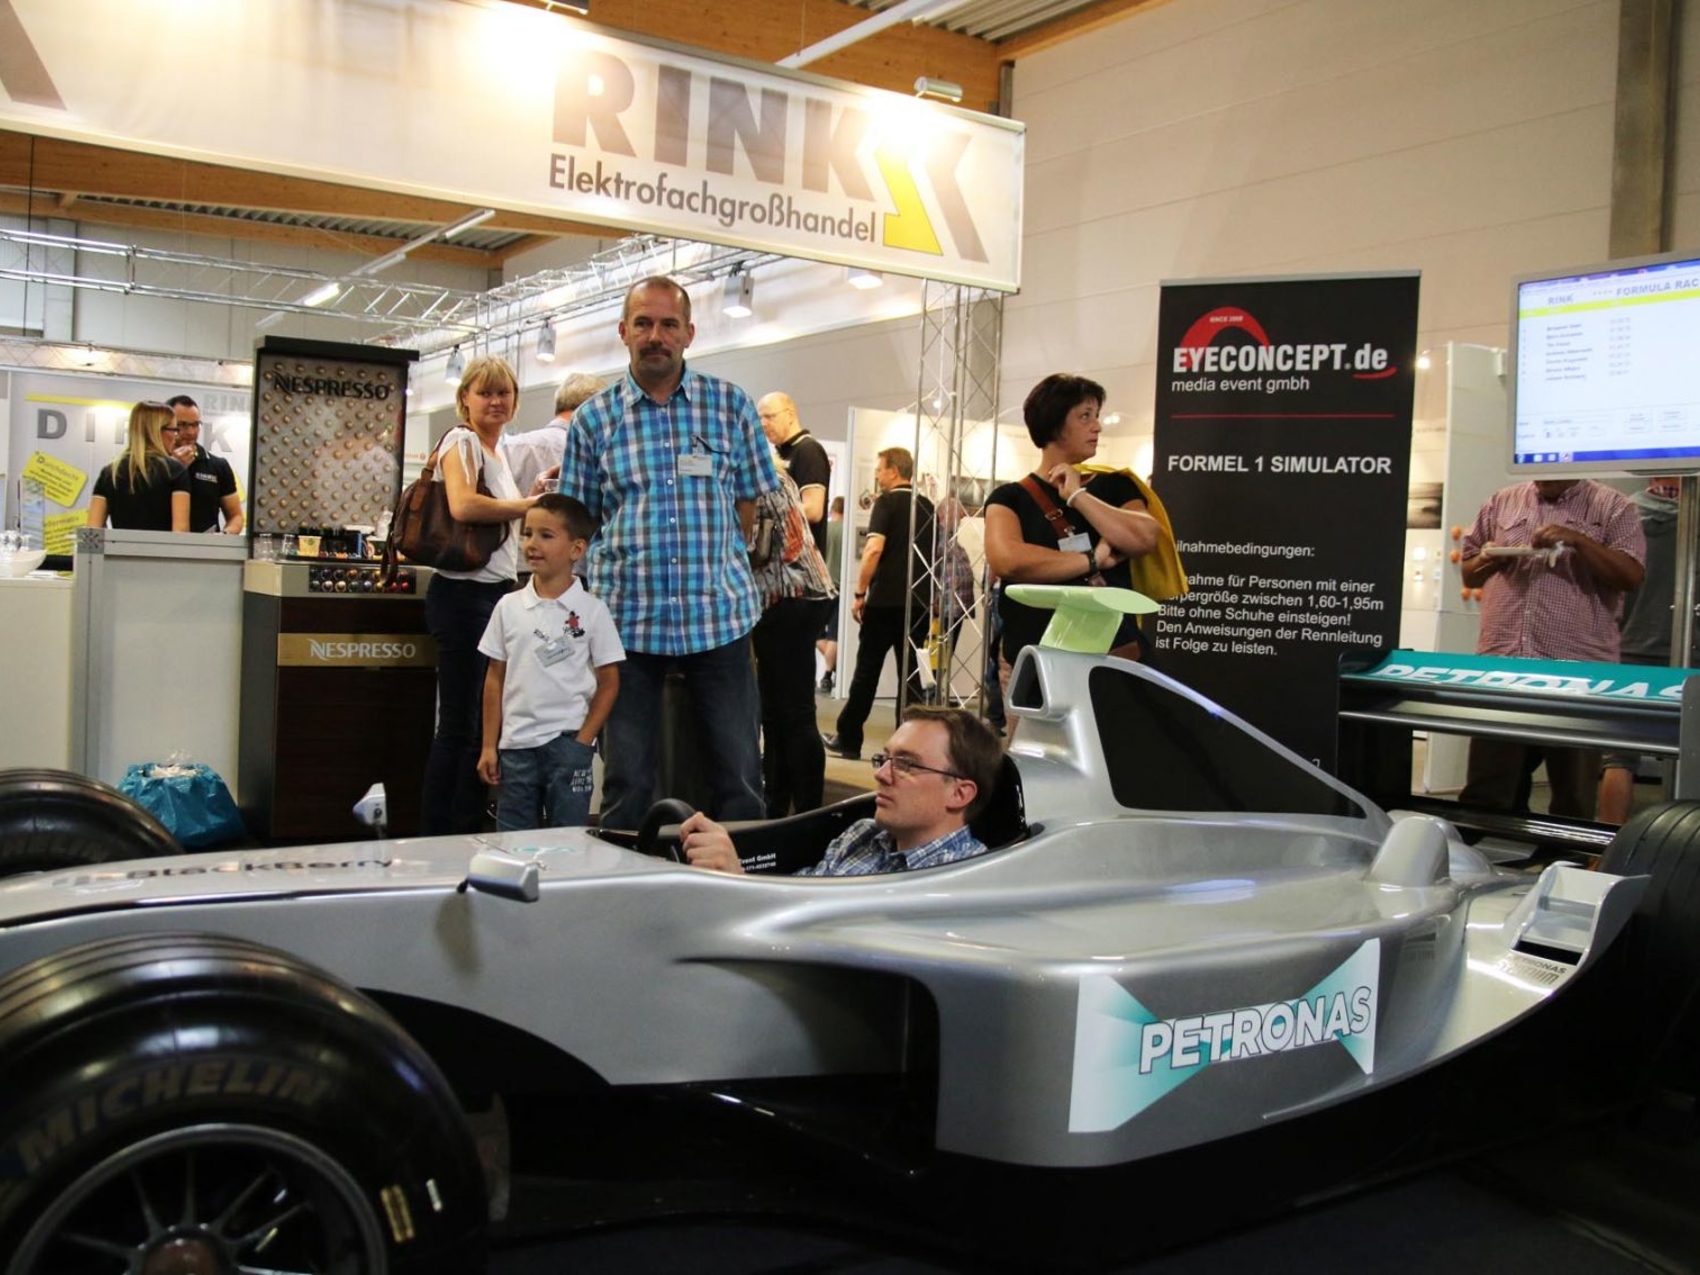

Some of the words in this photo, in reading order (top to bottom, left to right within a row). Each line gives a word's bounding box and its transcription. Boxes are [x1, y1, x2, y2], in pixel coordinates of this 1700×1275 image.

[552, 49, 876, 201] RINK
[549, 153, 876, 243] Elektrofachgroßhandel
[1616, 282, 1671, 296] FORMULA
[1173, 343, 1388, 373] EYECONCEPT.de
[273, 370, 390, 400] NESPRESSO
[1171, 378, 1216, 392] media
[1220, 379, 1262, 391] event
[1266, 377, 1310, 393] gmbh
[203, 393, 250, 412] RIN
[1167, 455, 1249, 472] FORMEL
[1254, 456, 1264, 472] 1
[1270, 457, 1392, 474] SIMULATOR
[1176, 540, 1315, 557] ilnahmebedingungen:
[1227, 574, 1246, 587] für
[1249, 575, 1311, 591] Personen
[1316, 579, 1337, 592] mit
[1340, 580, 1375, 593] einer
[1166, 590, 1239, 605] pergröße
[1241, 593, 1304, 608] zwischen
[1308, 596, 1384, 611] 1,60-1,95m
[1157, 603, 1186, 618] Bitte
[1188, 607, 1221, 619] ohne
[1225, 607, 1275, 622] Schuhe
[1278, 611, 1352, 626] einsteigen!
[1156, 620, 1182, 633] Den
[1184, 622, 1272, 640] Anweisungen
[1275, 627, 1298, 640] der
[1301, 629, 1383, 647] Rennleitung
[308, 638, 416, 661] NESPRESSO
[1155, 636, 1170, 649] ist
[1172, 637, 1209, 654] Folge
[1212, 642, 1228, 652] zu
[1231, 641, 1278, 656] leisten.
[1138, 987, 1372, 1075] PETRONAS
[17, 1059, 330, 1172] MICHELIN
